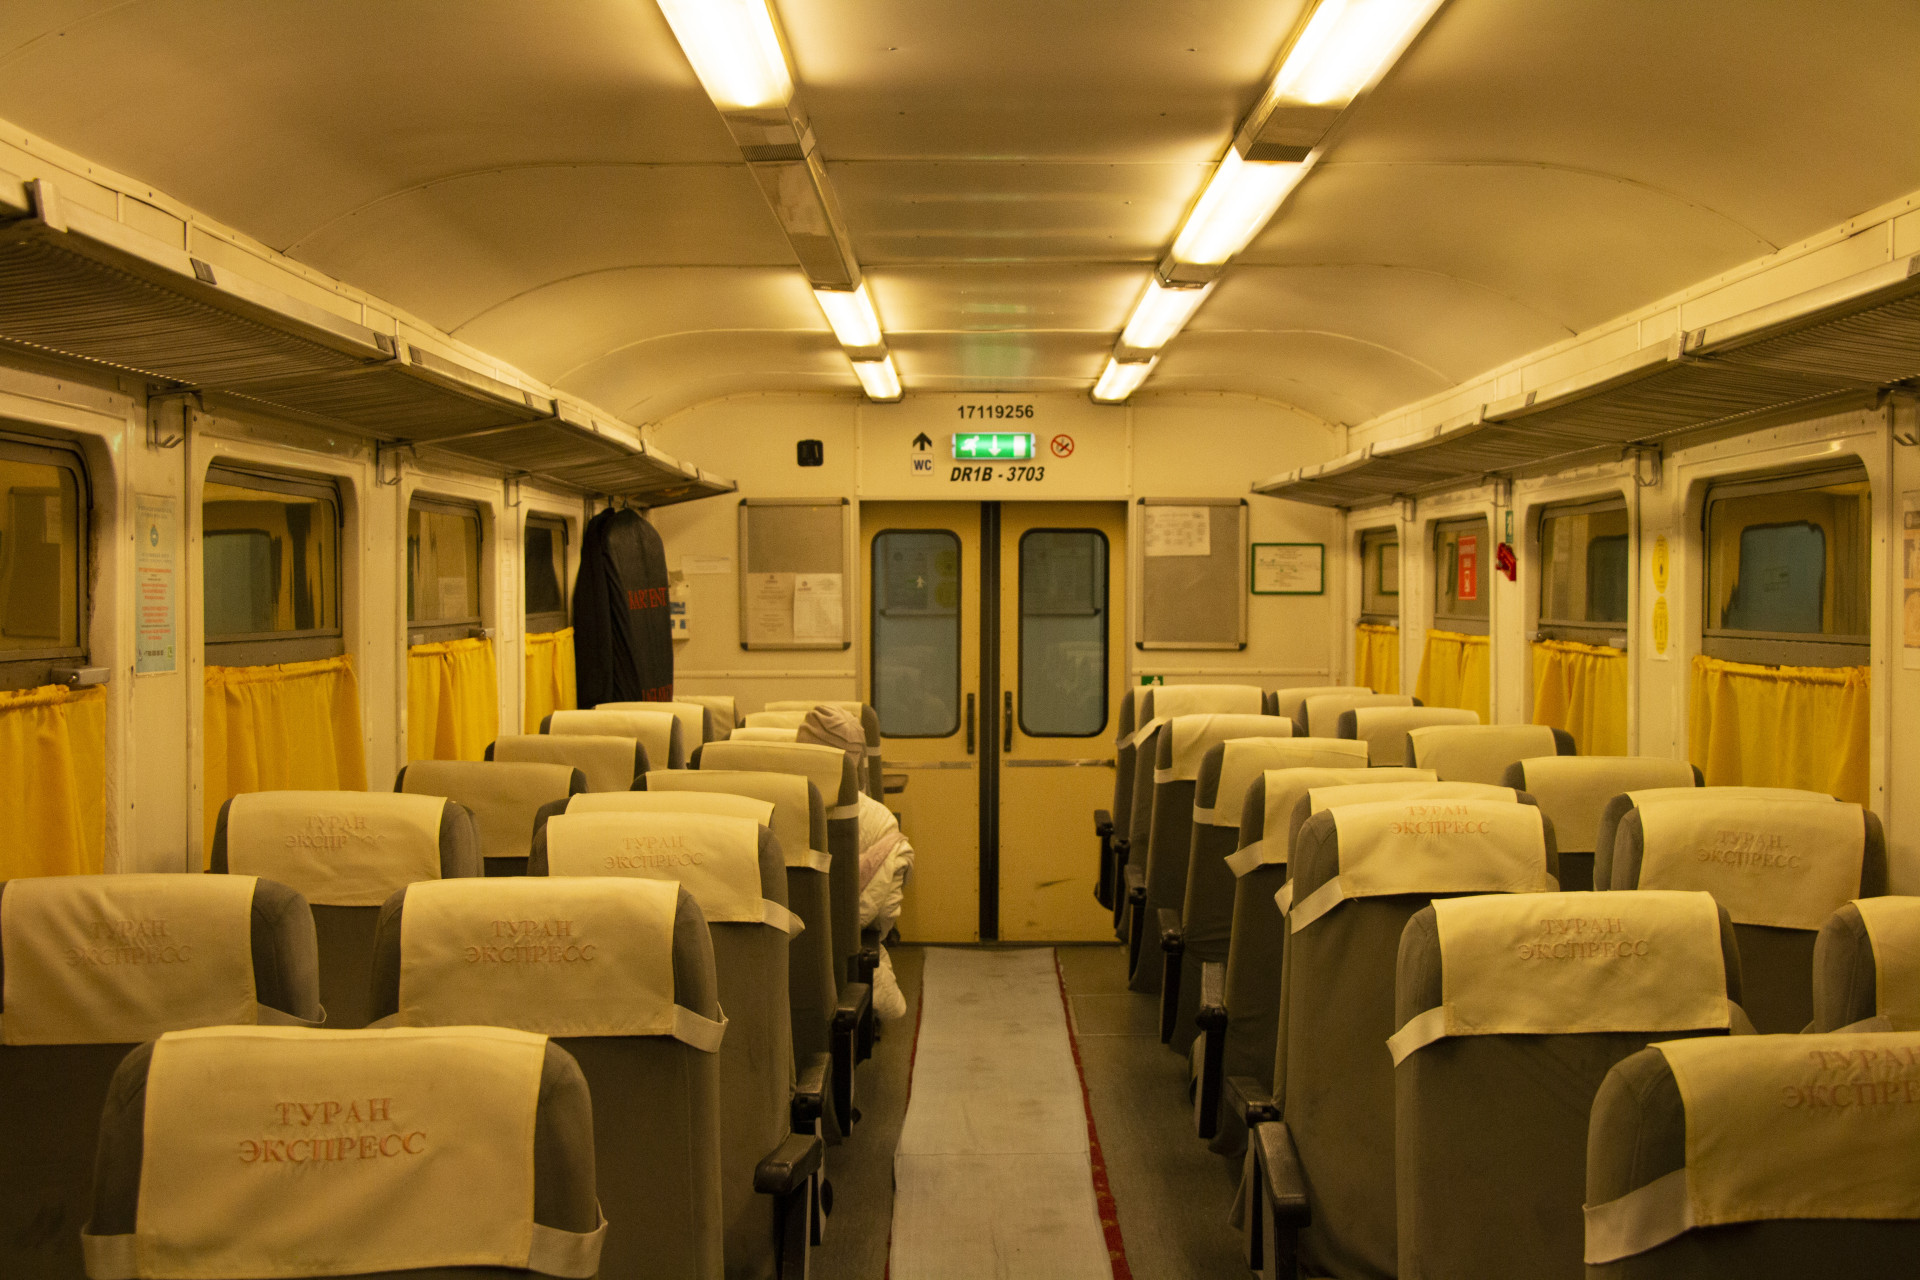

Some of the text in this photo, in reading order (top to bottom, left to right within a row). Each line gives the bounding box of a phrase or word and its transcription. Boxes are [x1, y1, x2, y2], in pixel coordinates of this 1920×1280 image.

[957, 404, 1035, 420] 17119256
[913, 459, 933, 471] WC
[950, 466, 994, 482] DR1B
[1006, 466, 1046, 482] 3703
[1404, 804, 1469, 817] ТУРАН
[1390, 820, 1490, 835] ЭКСПРЕСС
[622, 834, 688, 851] ТУРАН
[491, 919, 574, 938] ТУРАН
[1540, 917, 1624, 935] ТУРАН
[463, 944, 597, 964] ЭКСПРЕСС
[1518, 940, 1649, 961] ЭКСПРЕСС
[275, 1097, 393, 1127] ТУРАН
[239, 1131, 428, 1165] ЭКСПРЕСС
